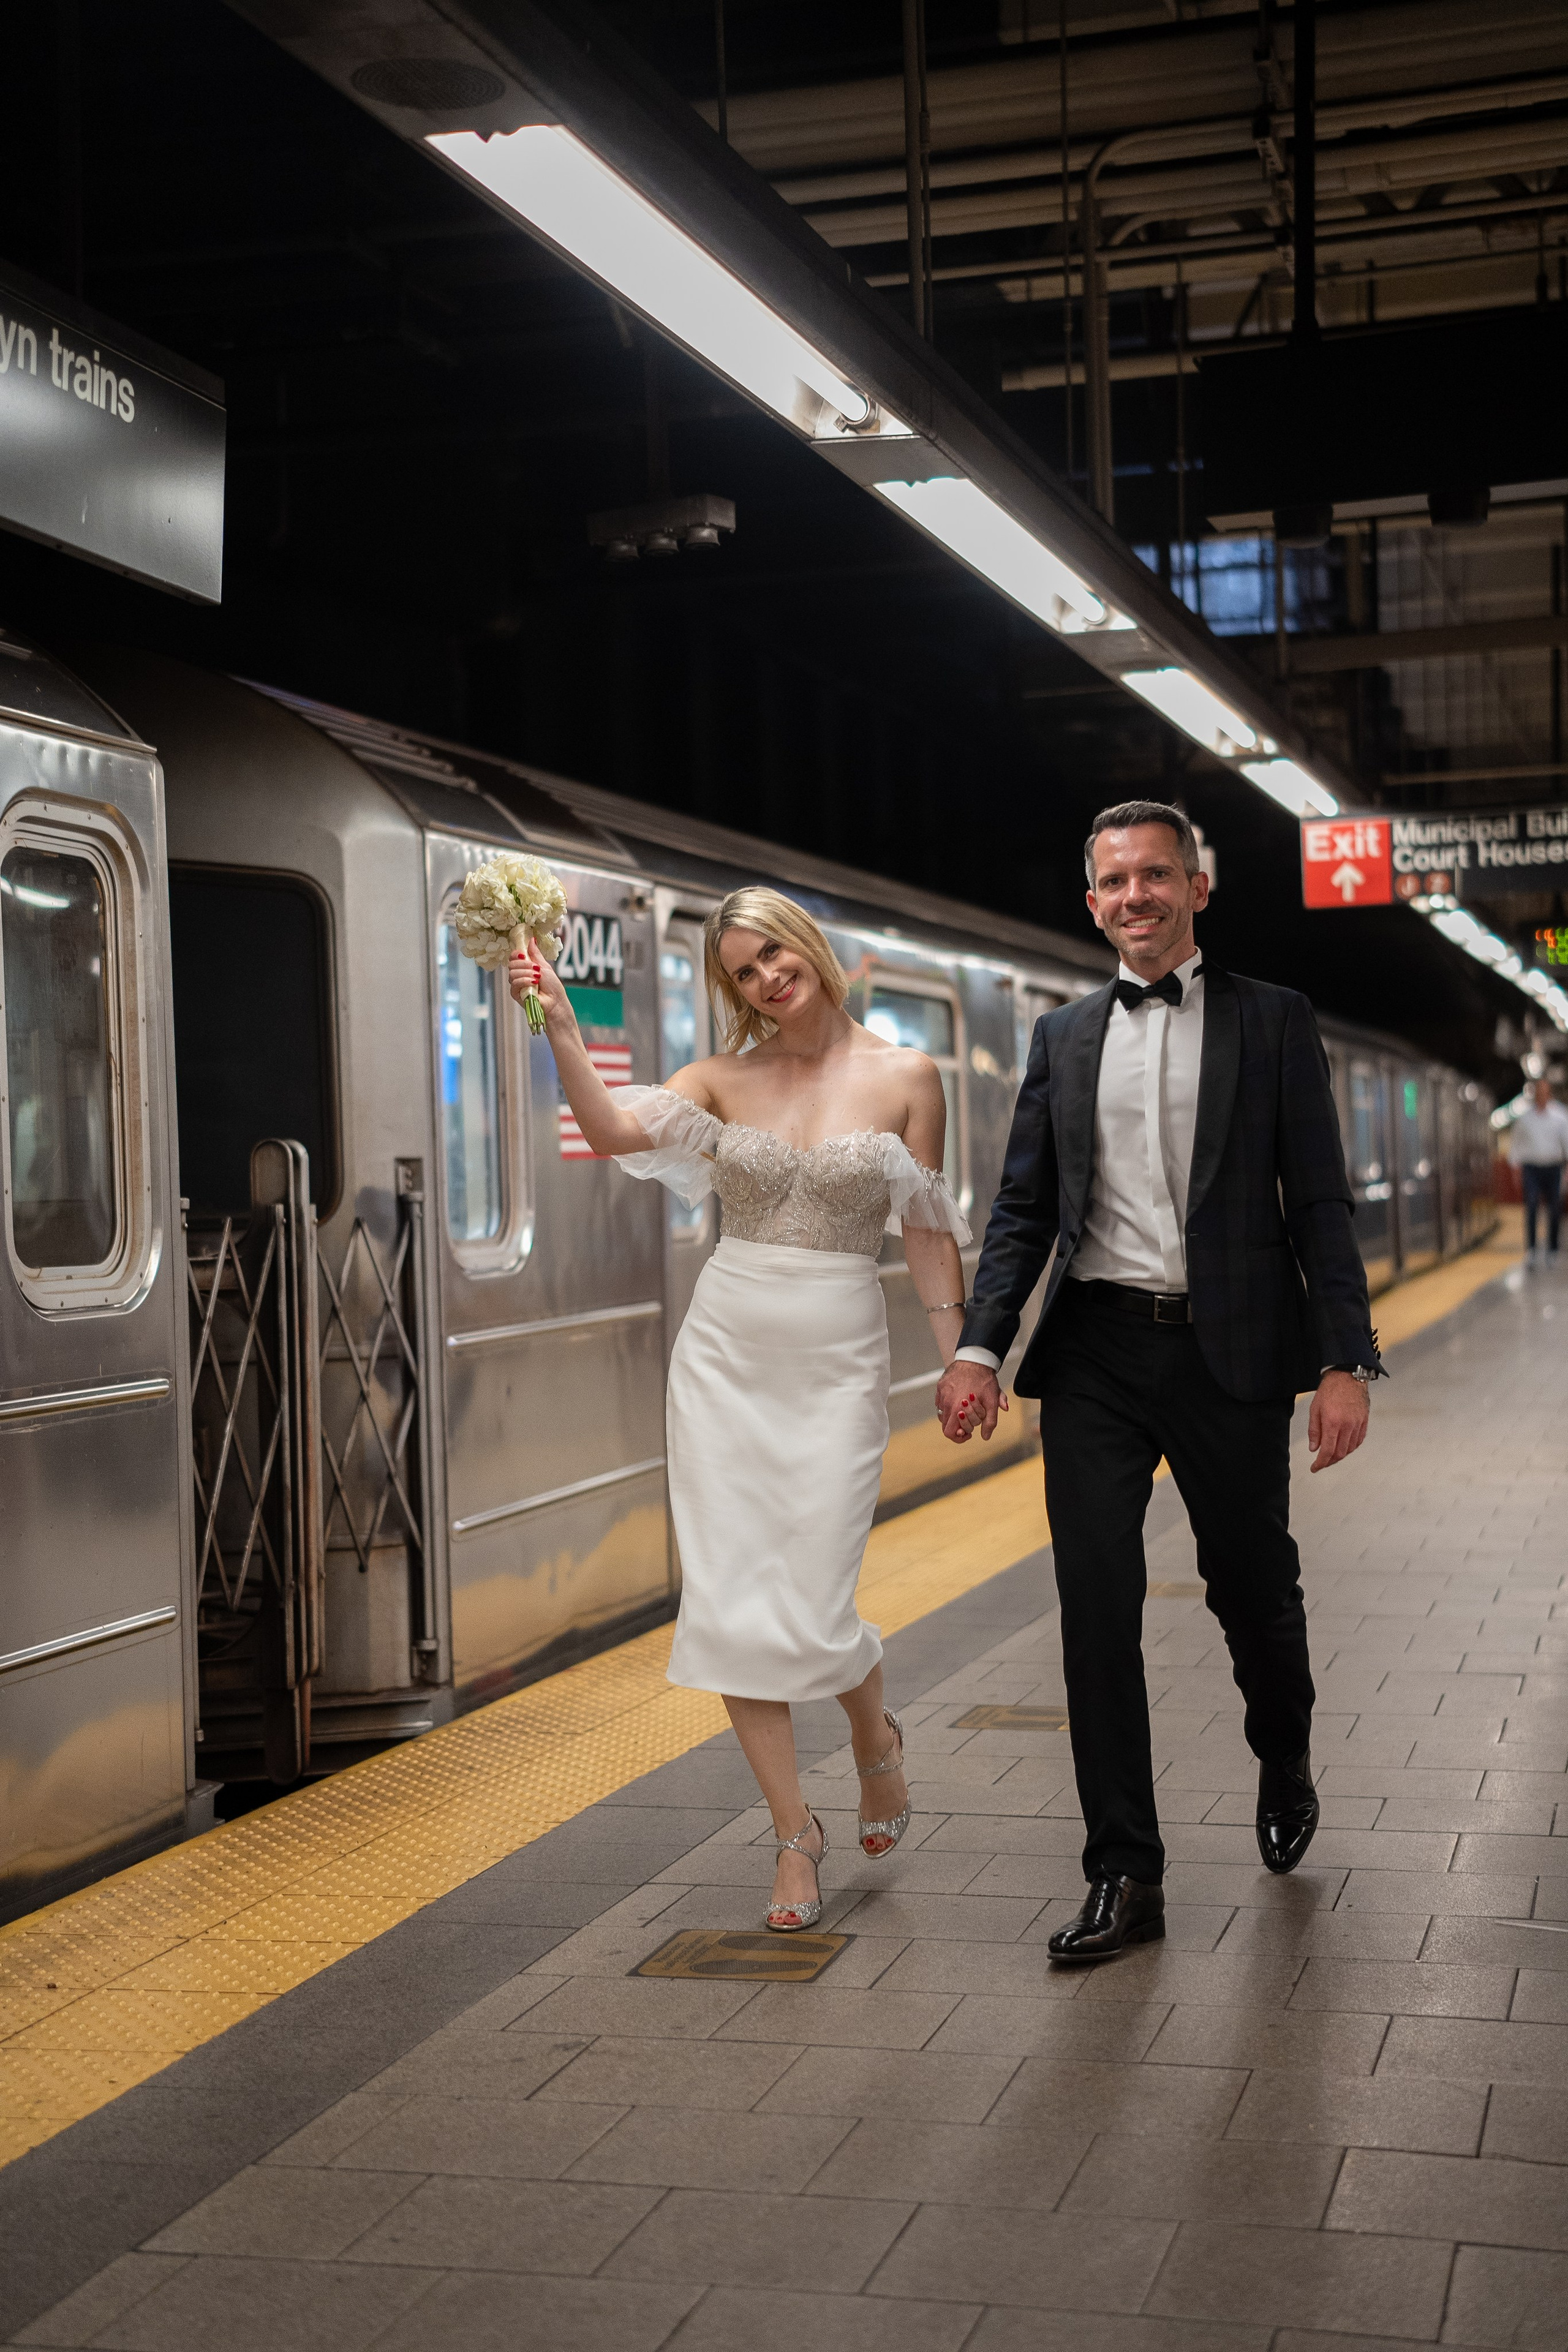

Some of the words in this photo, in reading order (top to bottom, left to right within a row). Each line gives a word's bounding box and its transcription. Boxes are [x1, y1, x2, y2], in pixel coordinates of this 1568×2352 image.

[49, 327, 135, 423] trains
[1305, 823, 1382, 862] Exit
[1392, 810, 1518, 846] Municipal
[1392, 845, 1469, 873] Court
[556, 913, 624, 984] 2044
